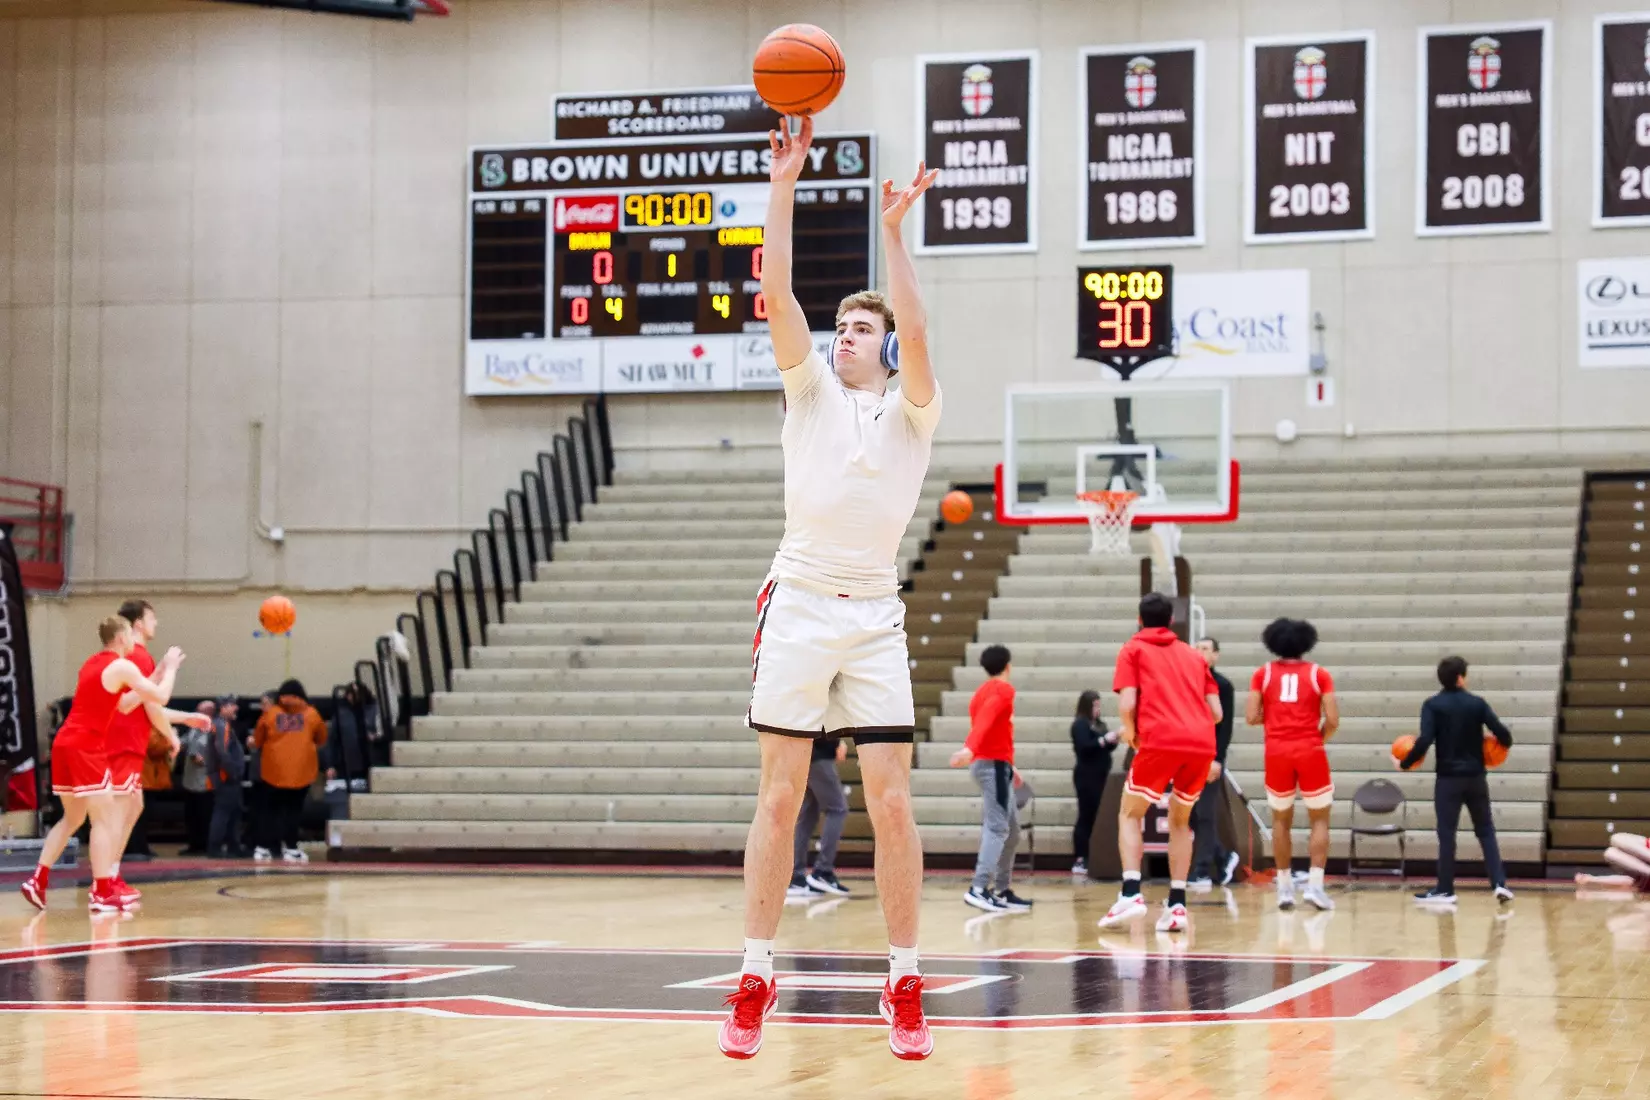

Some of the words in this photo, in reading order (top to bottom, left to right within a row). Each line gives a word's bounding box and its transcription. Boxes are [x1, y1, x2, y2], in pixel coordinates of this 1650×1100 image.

[557, 99, 634, 118] RICHARD
[637, 98, 657, 116] A.
[662, 94, 750, 116] FRIEDMAN
[608, 114, 725, 134] SCOREBOARD
[1108, 132, 1173, 160] NCAA
[1285, 131, 1335, 166] NIT
[1457, 121, 1511, 157] CBI
[512, 154, 628, 183] BROWN
[639, 146, 828, 179] UNIVERSY
[944, 140, 1008, 168] NCAA
[1089, 157, 1193, 181] TOURNAMENT
[1269, 182, 1350, 217] 2003
[1441, 173, 1525, 210] 2008
[625, 192, 711, 226] 90:00
[941, 196, 1012, 230] 1939
[1104, 189, 1177, 225] 1986
[593, 251, 613, 284] 0
[667, 253, 676, 277] 1
[1084, 271, 1163, 300] 90:00
[571, 298, 589, 324] 0
[605, 298, 622, 321] 4
[712, 294, 730, 319] 4
[1099, 300, 1151, 348] 30
[485, 353, 583, 381] BayCoast
[618, 362, 715, 382] SHAWMUT
[1280, 673, 1298, 703] 11
